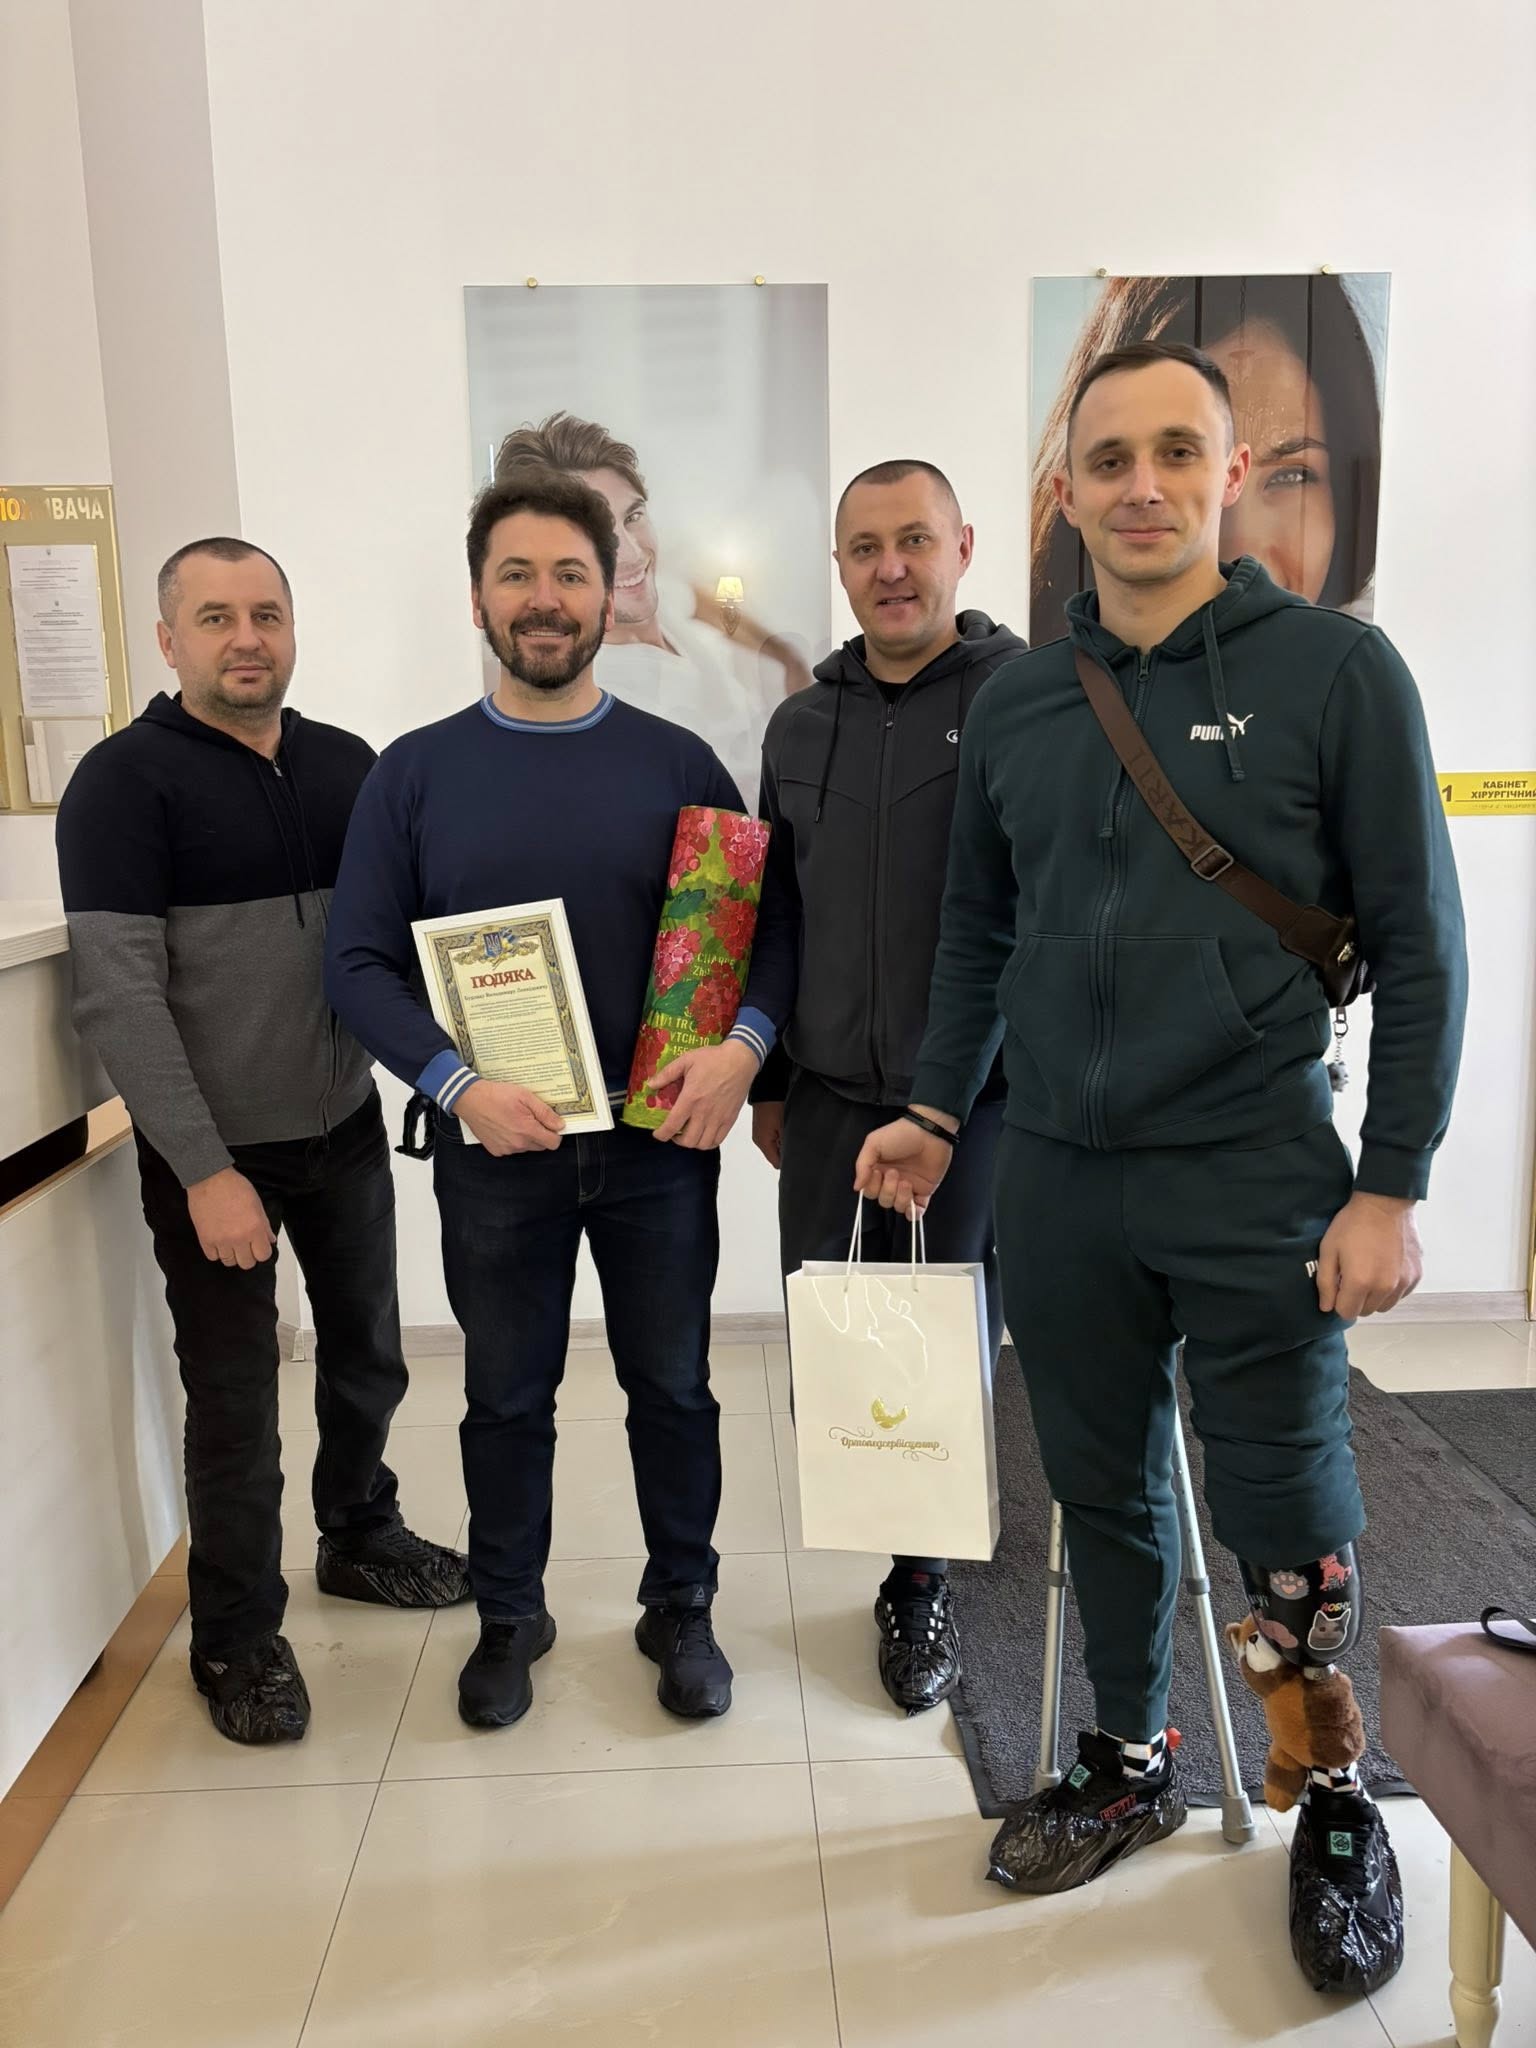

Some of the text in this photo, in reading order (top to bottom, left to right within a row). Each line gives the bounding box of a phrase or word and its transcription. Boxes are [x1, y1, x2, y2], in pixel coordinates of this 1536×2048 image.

[1442, 784, 1452, 802] 1
[1483, 780, 1528, 789] КАБІНЕТ
[470, 967, 537, 989] ПОДЯКА
